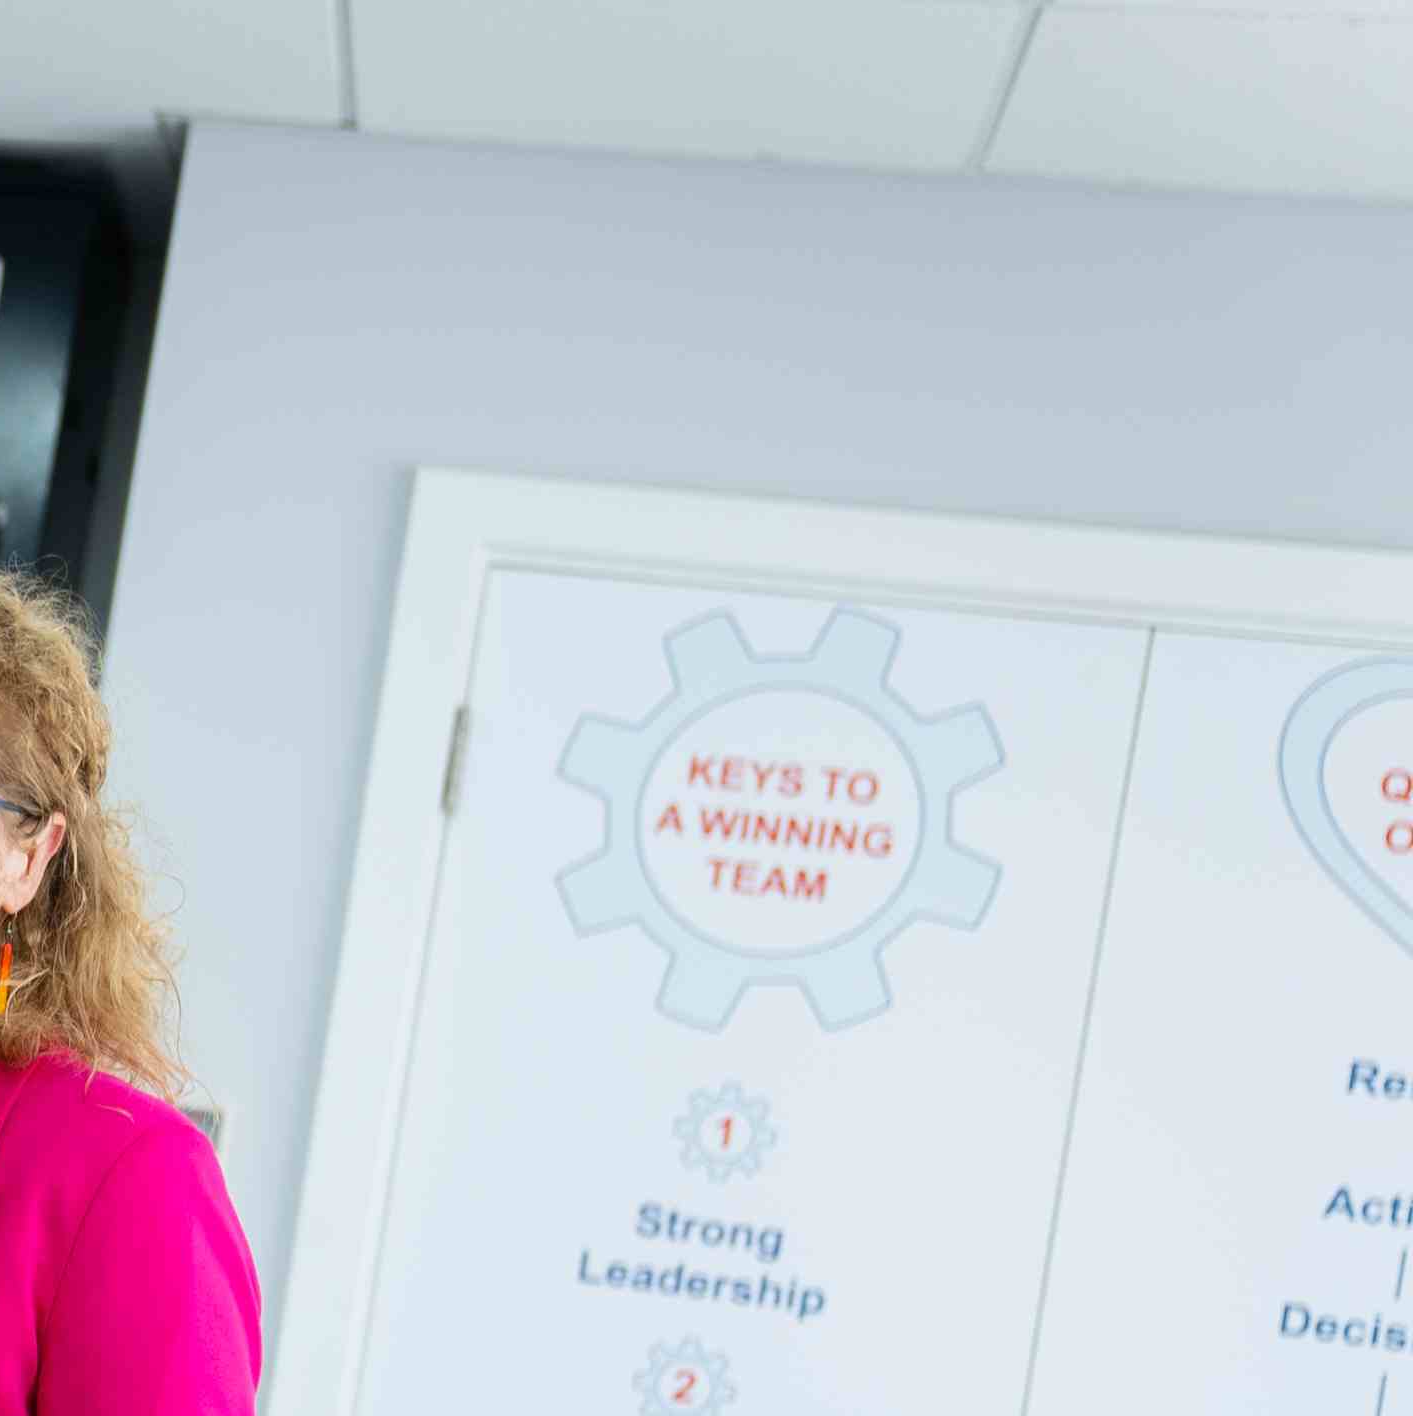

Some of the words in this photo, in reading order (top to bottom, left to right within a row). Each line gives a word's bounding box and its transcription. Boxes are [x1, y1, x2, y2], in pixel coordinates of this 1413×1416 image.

[686, 753, 805, 799] KEYS
[824, 765, 882, 805] TO
[655, 802, 686, 838] A
[698, 808, 895, 859] WINNING
[708, 859, 828, 903] TEAM
[715, 1116, 735, 1149] 1
[633, 1202, 787, 1261] Strong
[1322, 1184, 1413, 1228] Acti
[574, 1251, 828, 1319] Leadership
[1276, 1301, 1413, 1353] Decis
[671, 1368, 700, 1407] 2
